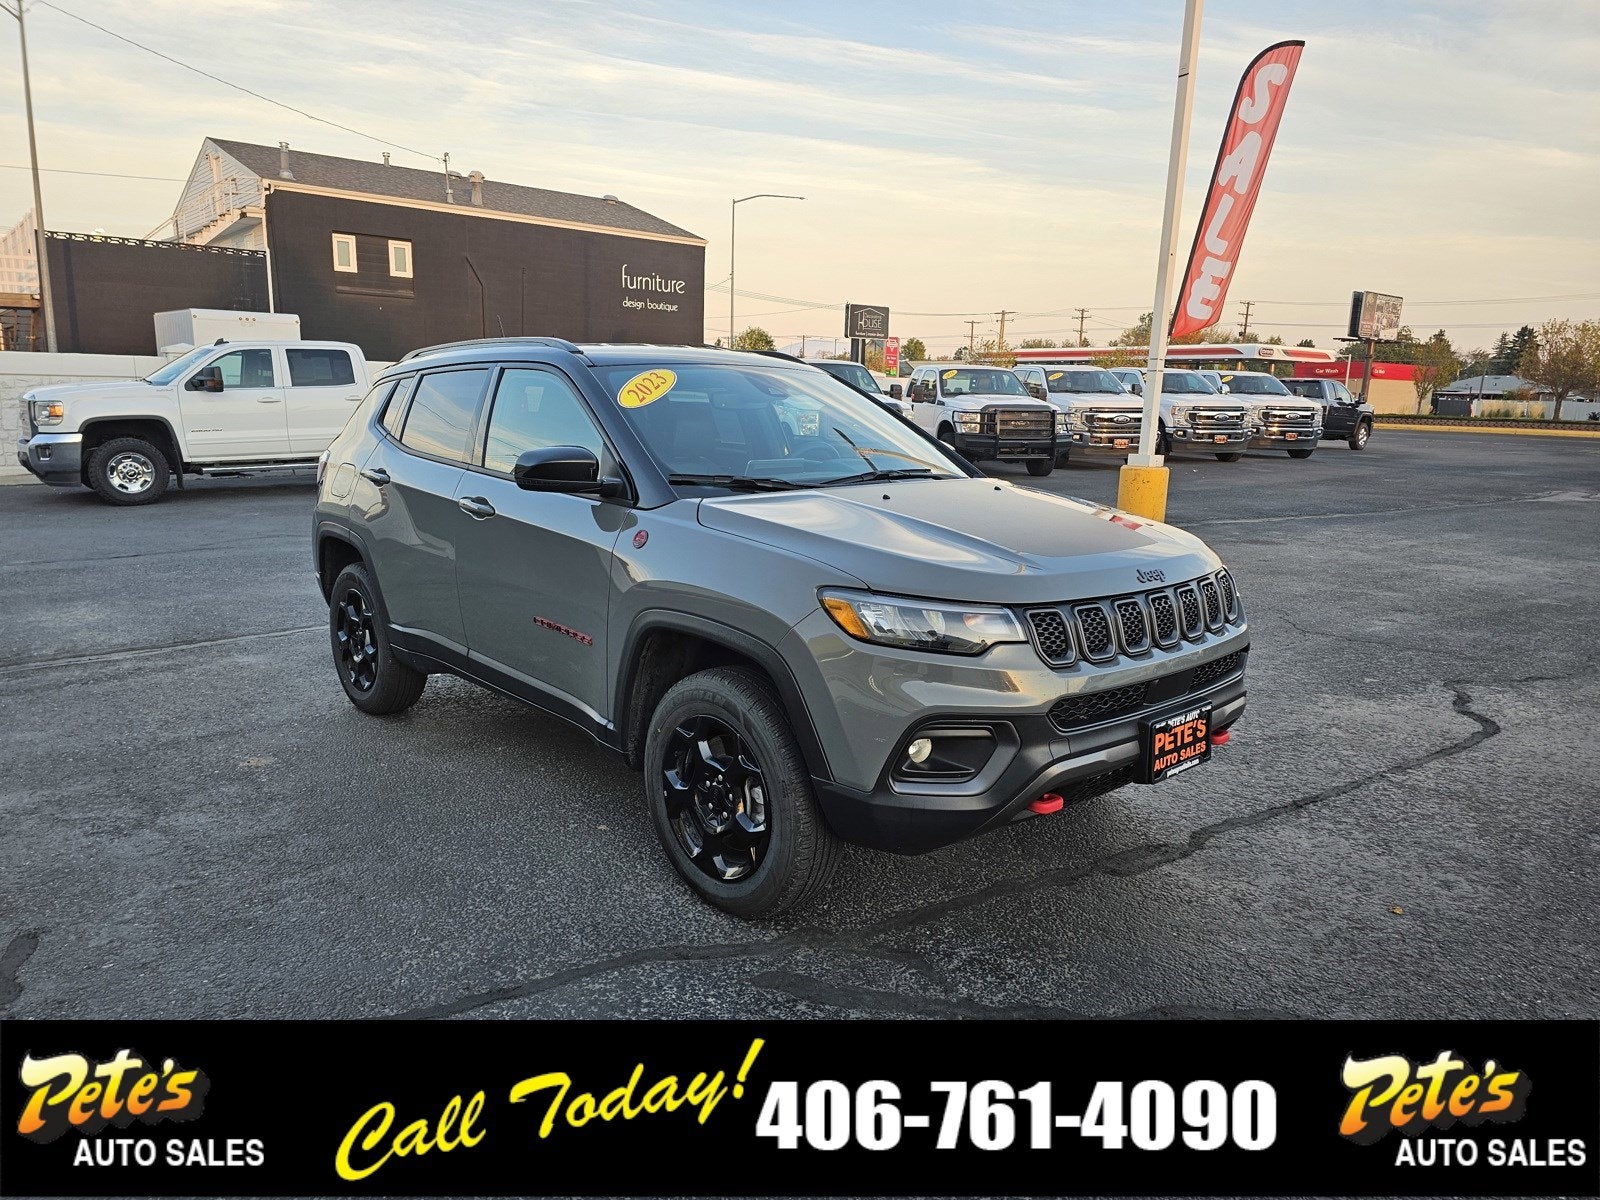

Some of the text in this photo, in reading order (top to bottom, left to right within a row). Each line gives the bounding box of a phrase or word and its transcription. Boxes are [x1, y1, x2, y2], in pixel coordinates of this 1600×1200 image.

[1186, 63, 1288, 319] SALE
[621, 263, 686, 294] furniture
[622, 296, 679, 312] design boutique
[627, 371, 667, 404] 2023
[1136, 568, 1167, 584] Jeep
[1154, 719, 1207, 756] PETE'S
[1153, 752, 1179, 772] AUTO
[1180, 740, 1207, 761] SALES
